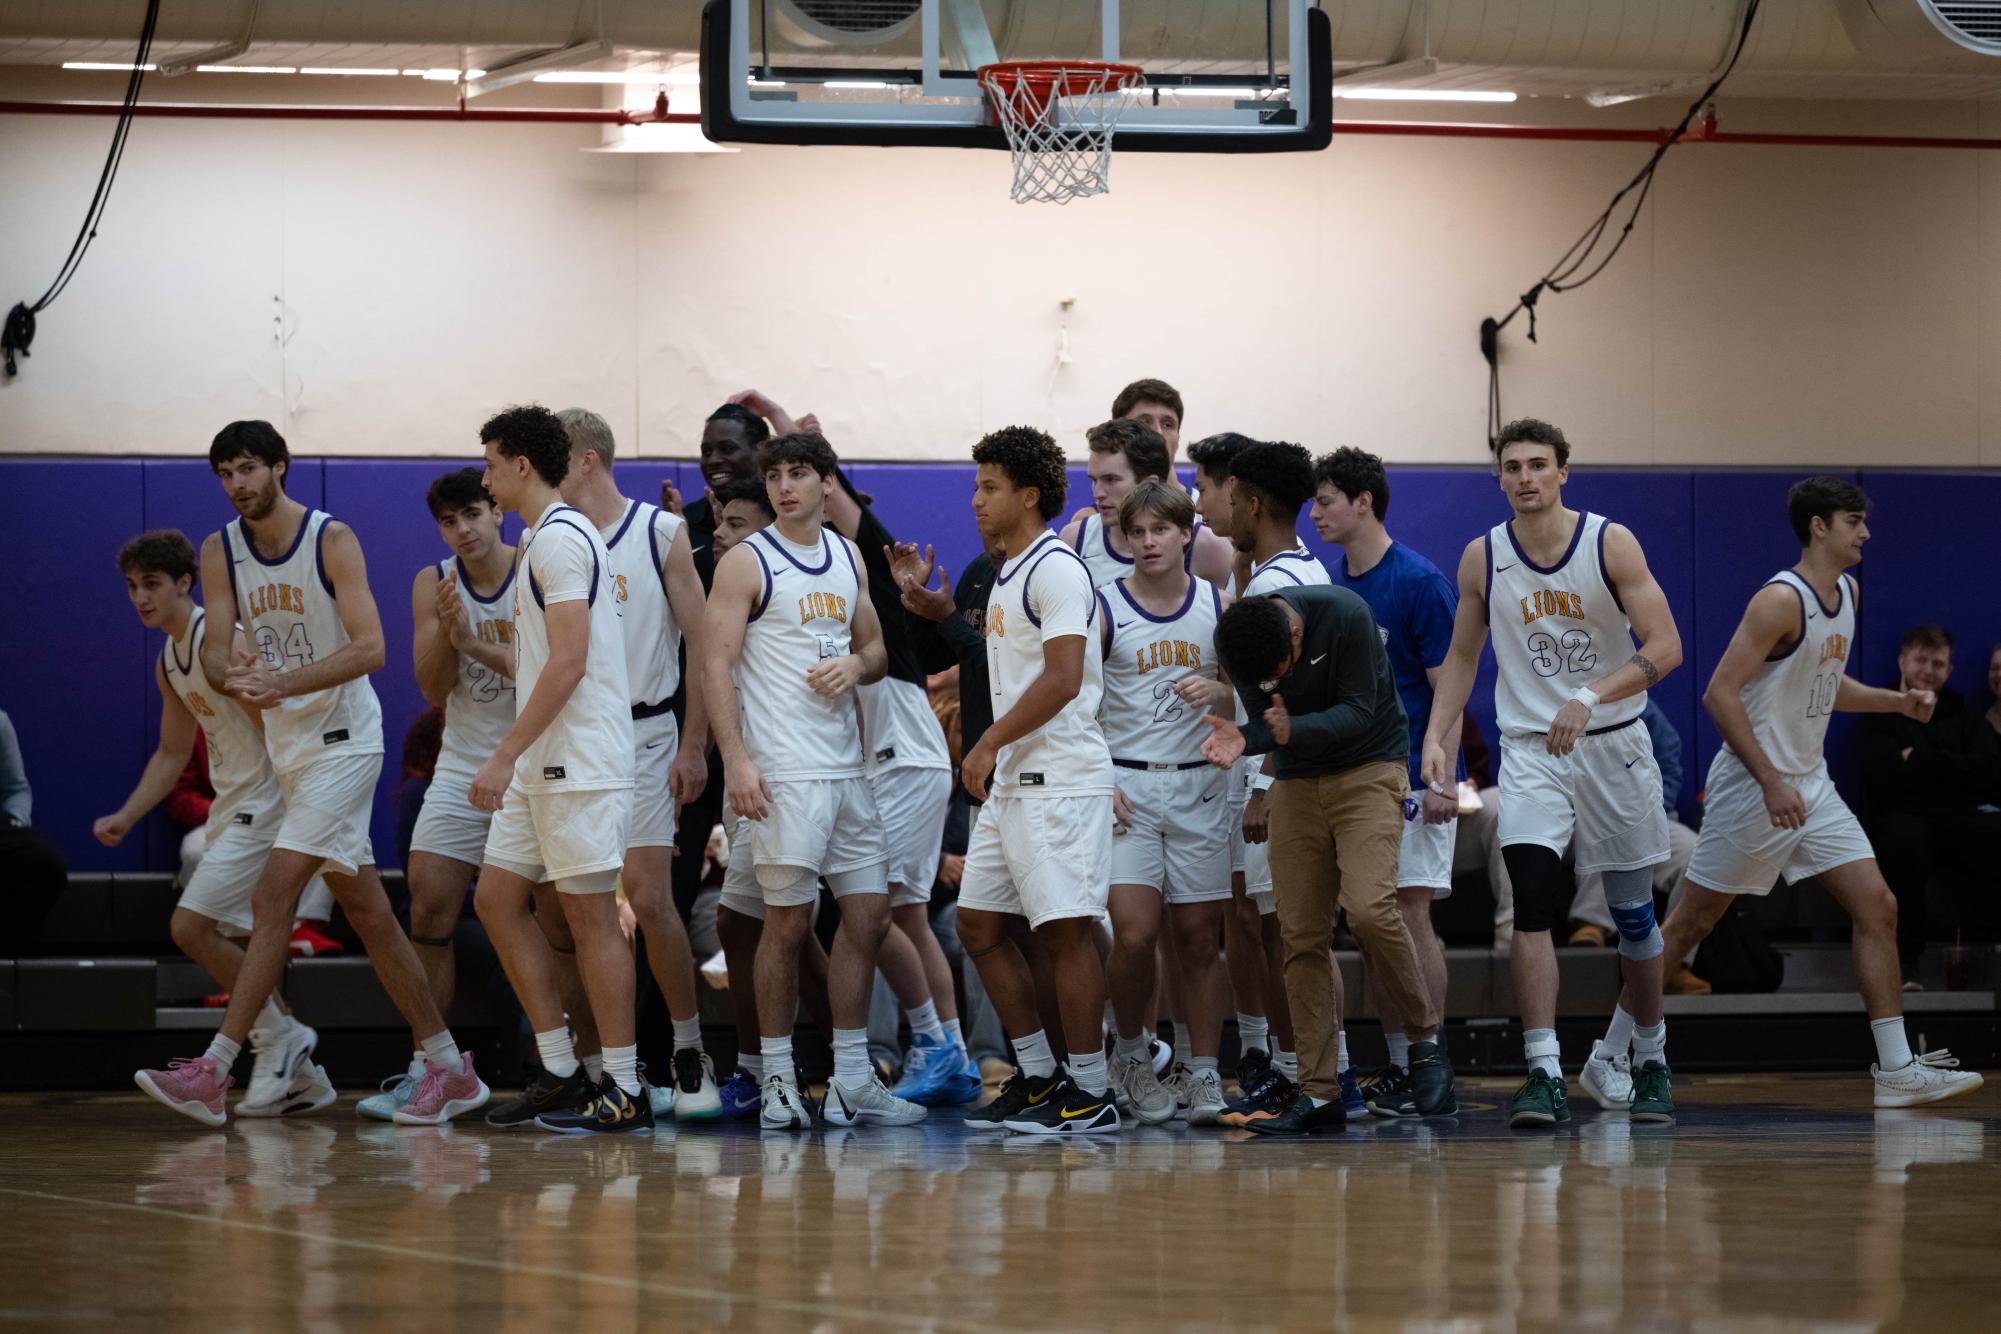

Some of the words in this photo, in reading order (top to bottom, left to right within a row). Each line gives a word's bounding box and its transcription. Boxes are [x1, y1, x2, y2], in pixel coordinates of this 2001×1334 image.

[249, 583, 305, 620] LIONS
[799, 591, 847, 625] LIONS
[1521, 589, 1585, 625] LIONS
[255, 622, 314, 672] 34
[476, 619, 514, 643] ION
[1136, 640, 1201, 675] LIONS
[1527, 629, 1597, 678] 32
[1153, 679, 1183, 723] 2
[1806, 672, 1838, 718] 10
